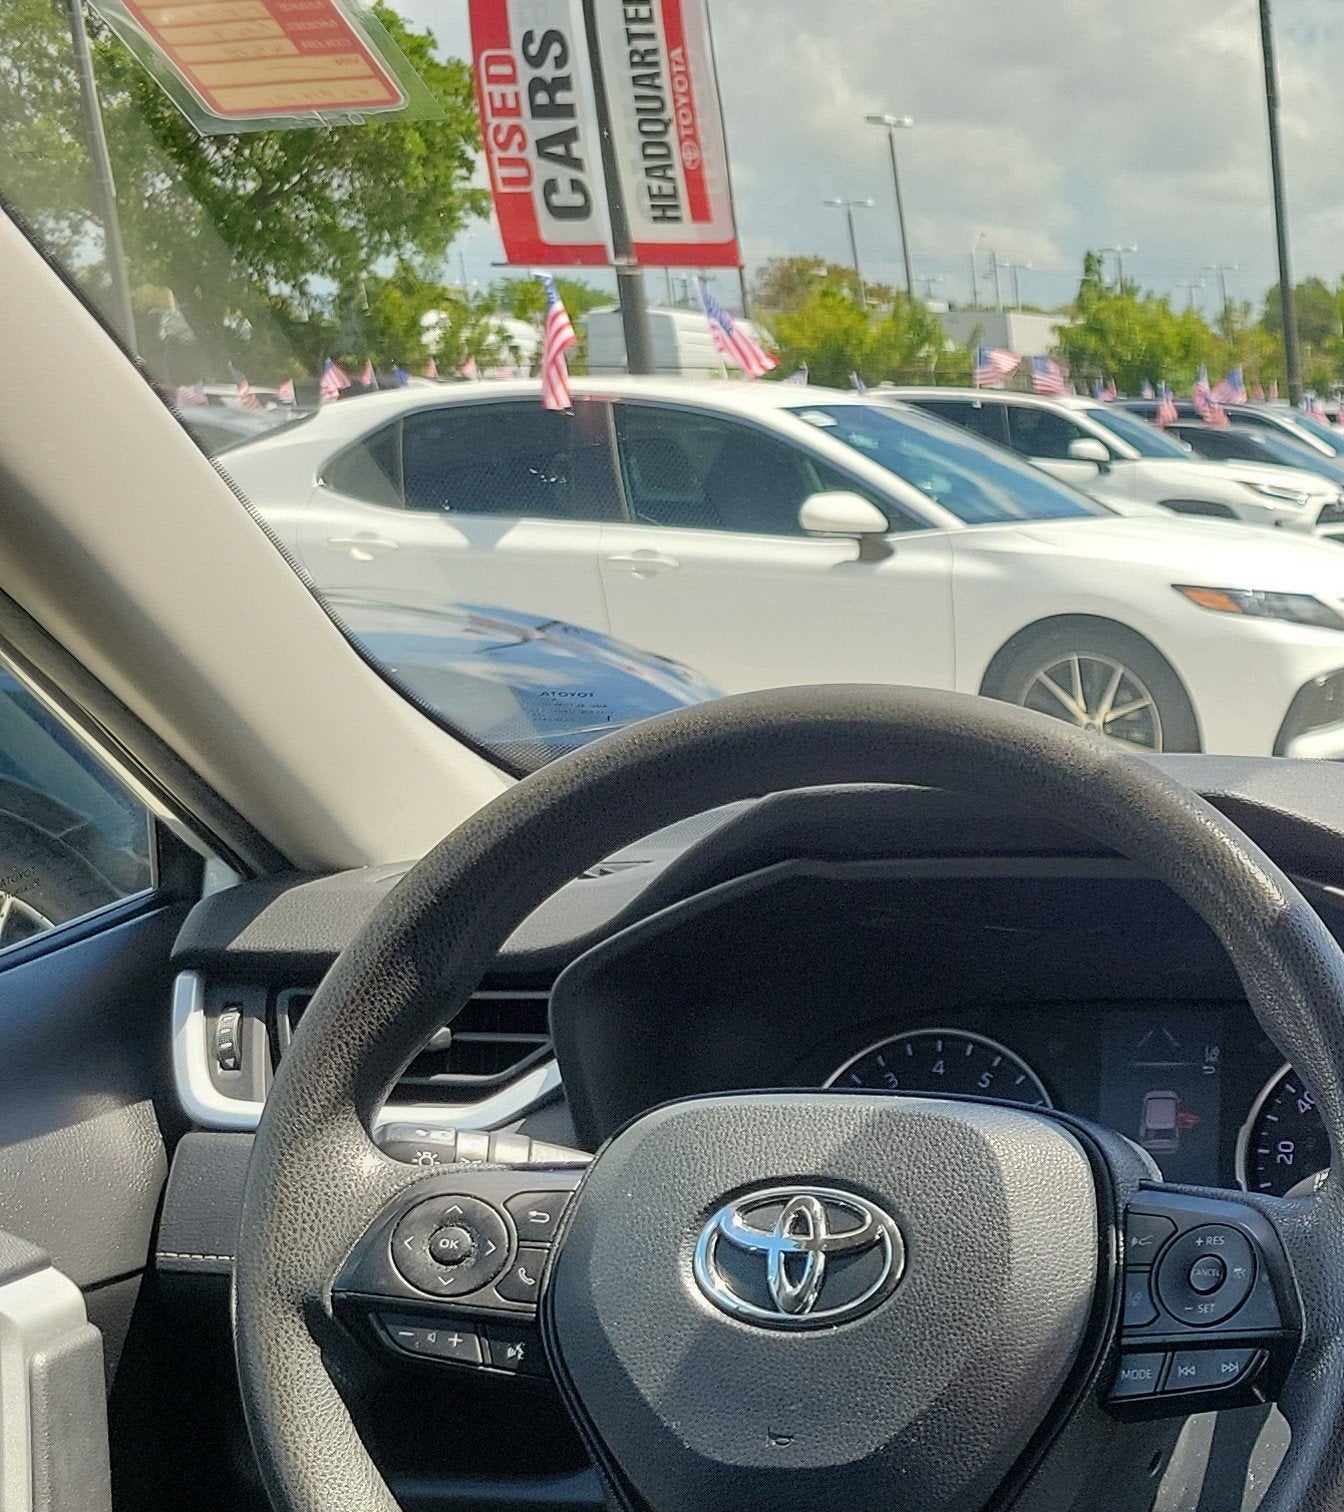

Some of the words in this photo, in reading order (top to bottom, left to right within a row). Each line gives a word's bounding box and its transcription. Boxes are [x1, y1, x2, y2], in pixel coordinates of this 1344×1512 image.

[670, 47, 701, 146] TOYOTA
[482, 51, 533, 191] USED
[622, 0, 683, 224] HEADQUARTE
[522, 29, 593, 221] CARS
[932, 1060, 945, 1075] 4
[884, 1072, 899, 1088] 3
[979, 1072, 993, 1088] 5
[1276, 1141, 1294, 1165] 20
[440, 1238, 459, 1249] OK
[1121, 1370, 1152, 1380] MODE
